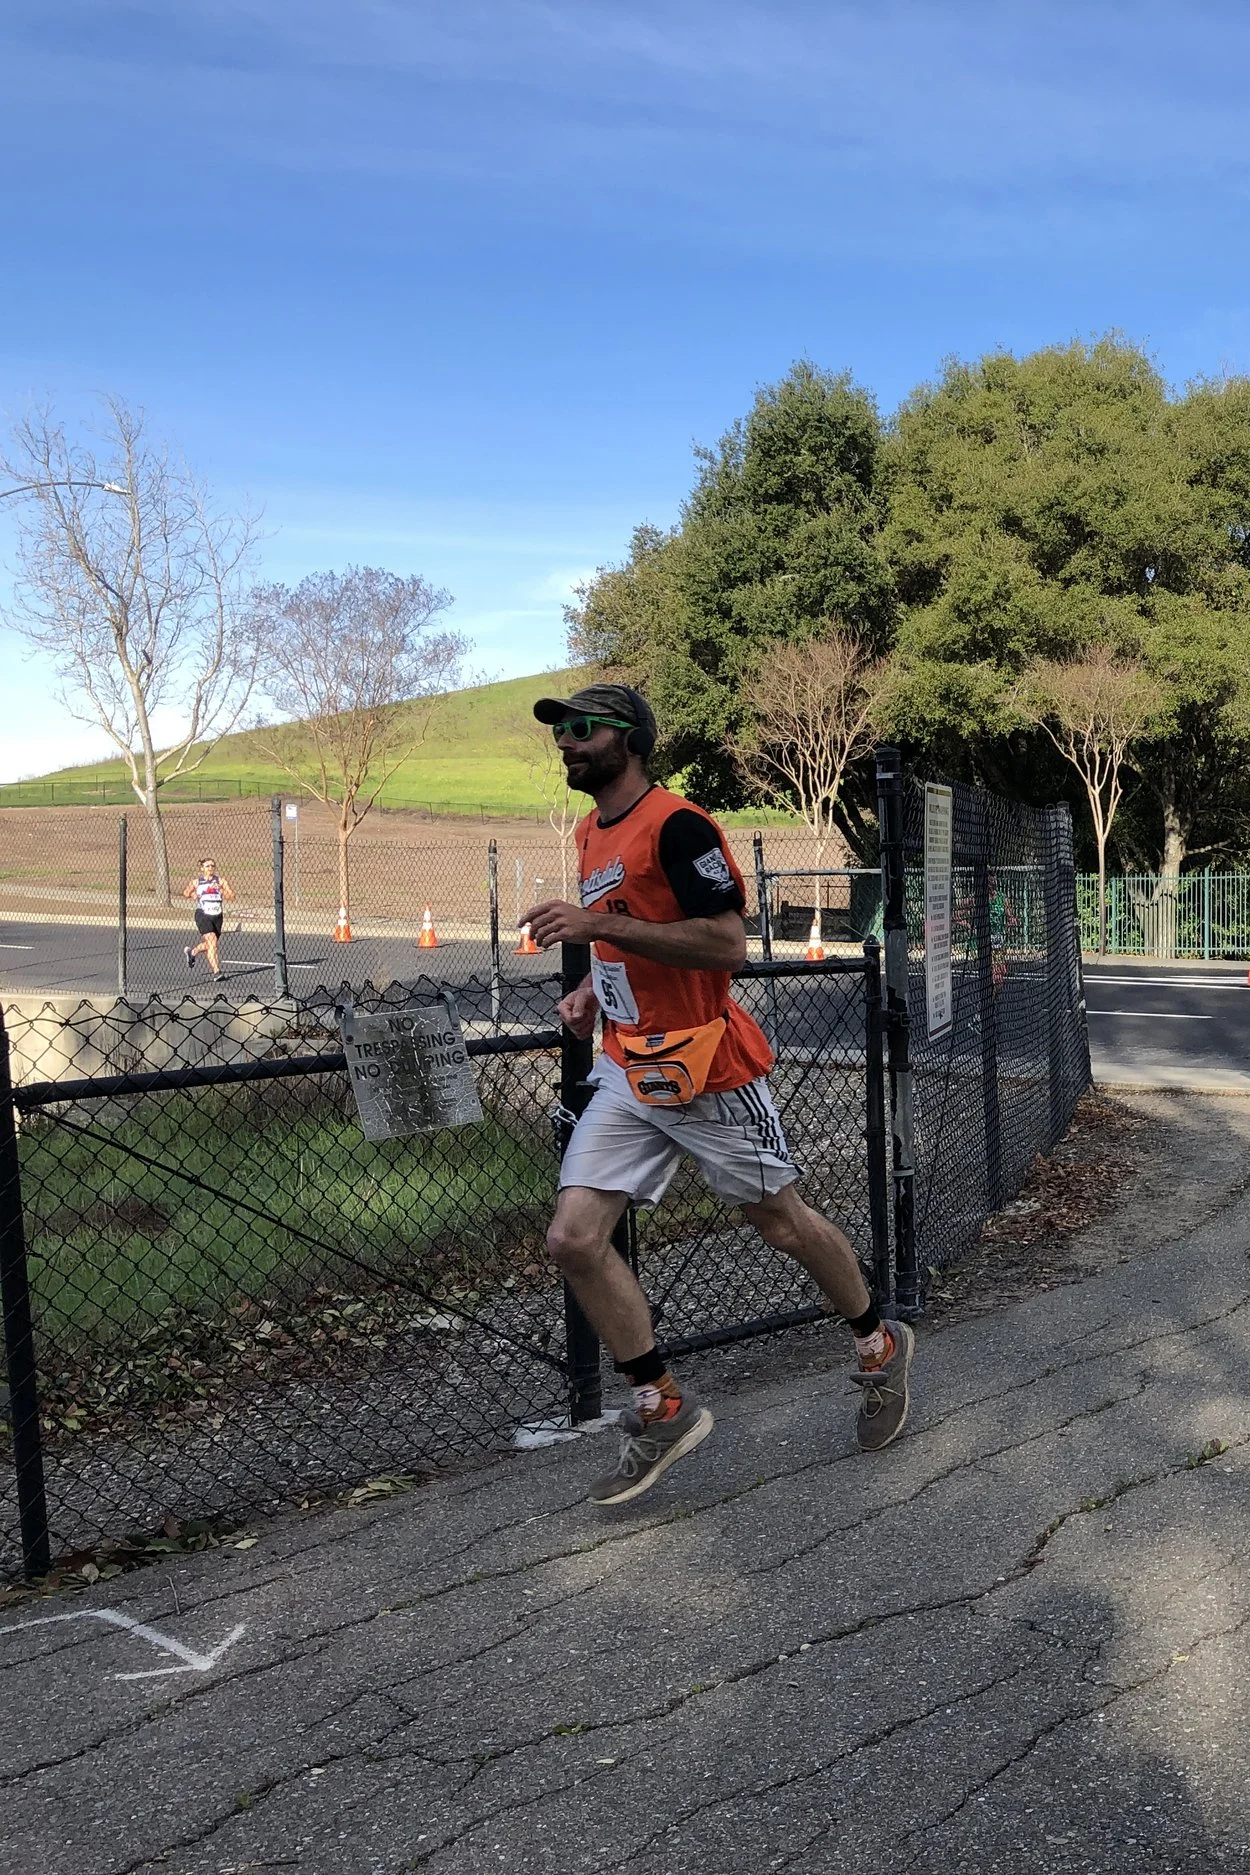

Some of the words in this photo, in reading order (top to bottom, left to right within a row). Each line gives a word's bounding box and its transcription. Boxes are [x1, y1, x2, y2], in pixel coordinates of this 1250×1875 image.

[388, 1016, 414, 1033] NO
[354, 1063, 381, 1080] NO
[390, 1050, 465, 1076] DUPING
